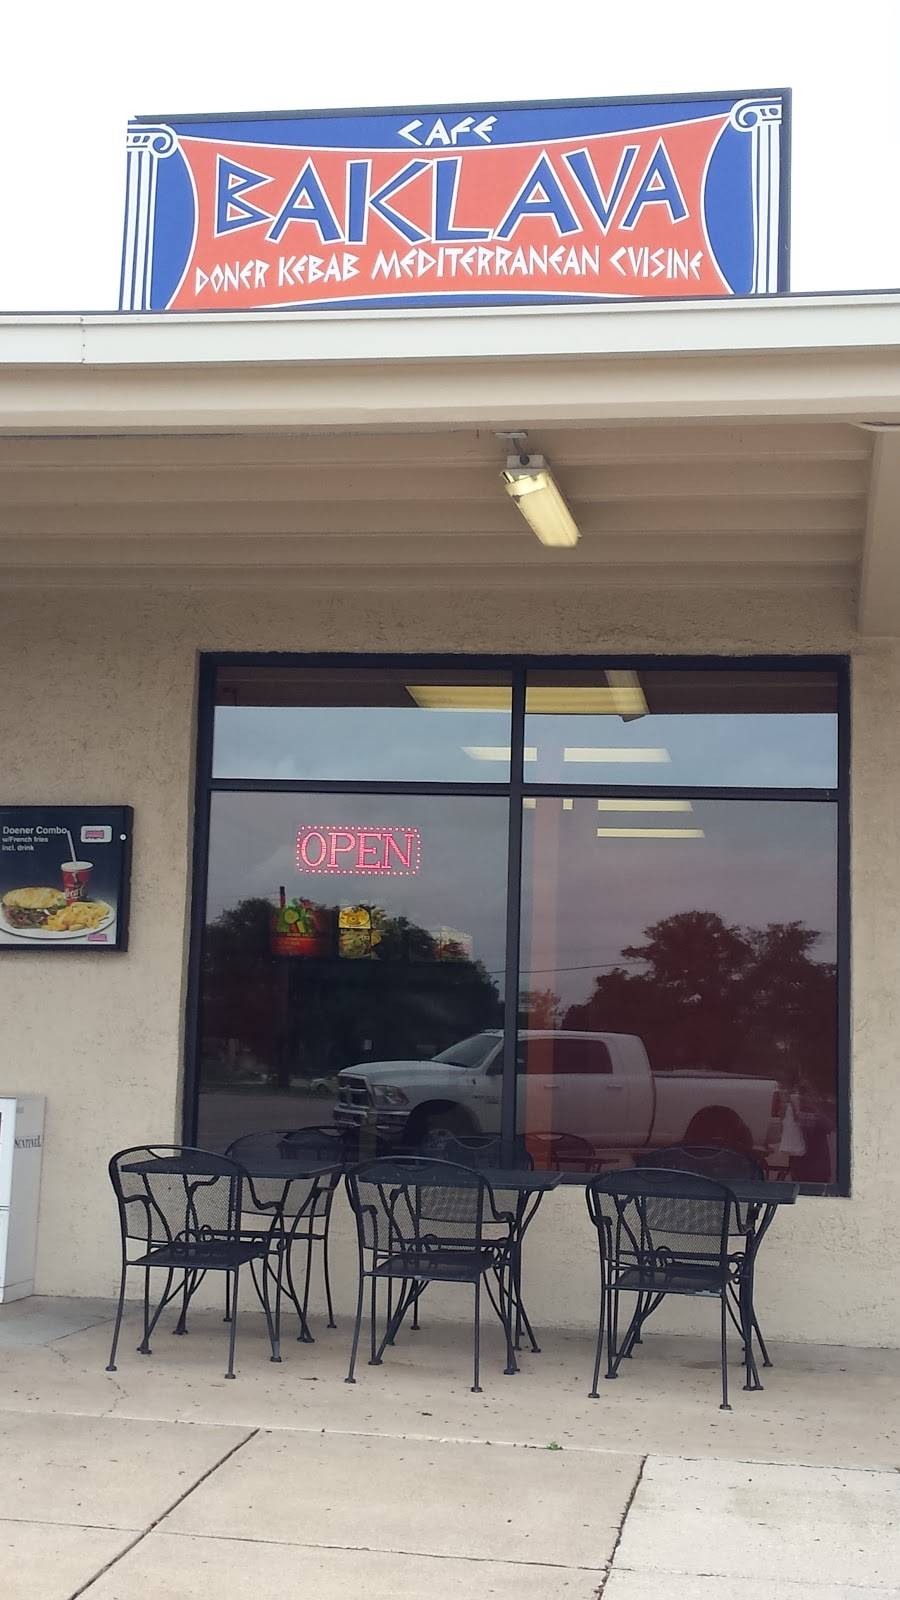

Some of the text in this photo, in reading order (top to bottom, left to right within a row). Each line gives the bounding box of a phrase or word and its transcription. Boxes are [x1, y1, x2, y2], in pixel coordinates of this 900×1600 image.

[397, 115, 498, 146] CAFE
[214, 136, 690, 246] BAKLAVA
[194, 259, 270, 296] DONER
[278, 252, 360, 287] KEBAB
[371, 245, 600, 280] MEDITERRANEAN
[3, 826, 68, 835] Doener Combo
[301, 832, 415, 869] OPEN
